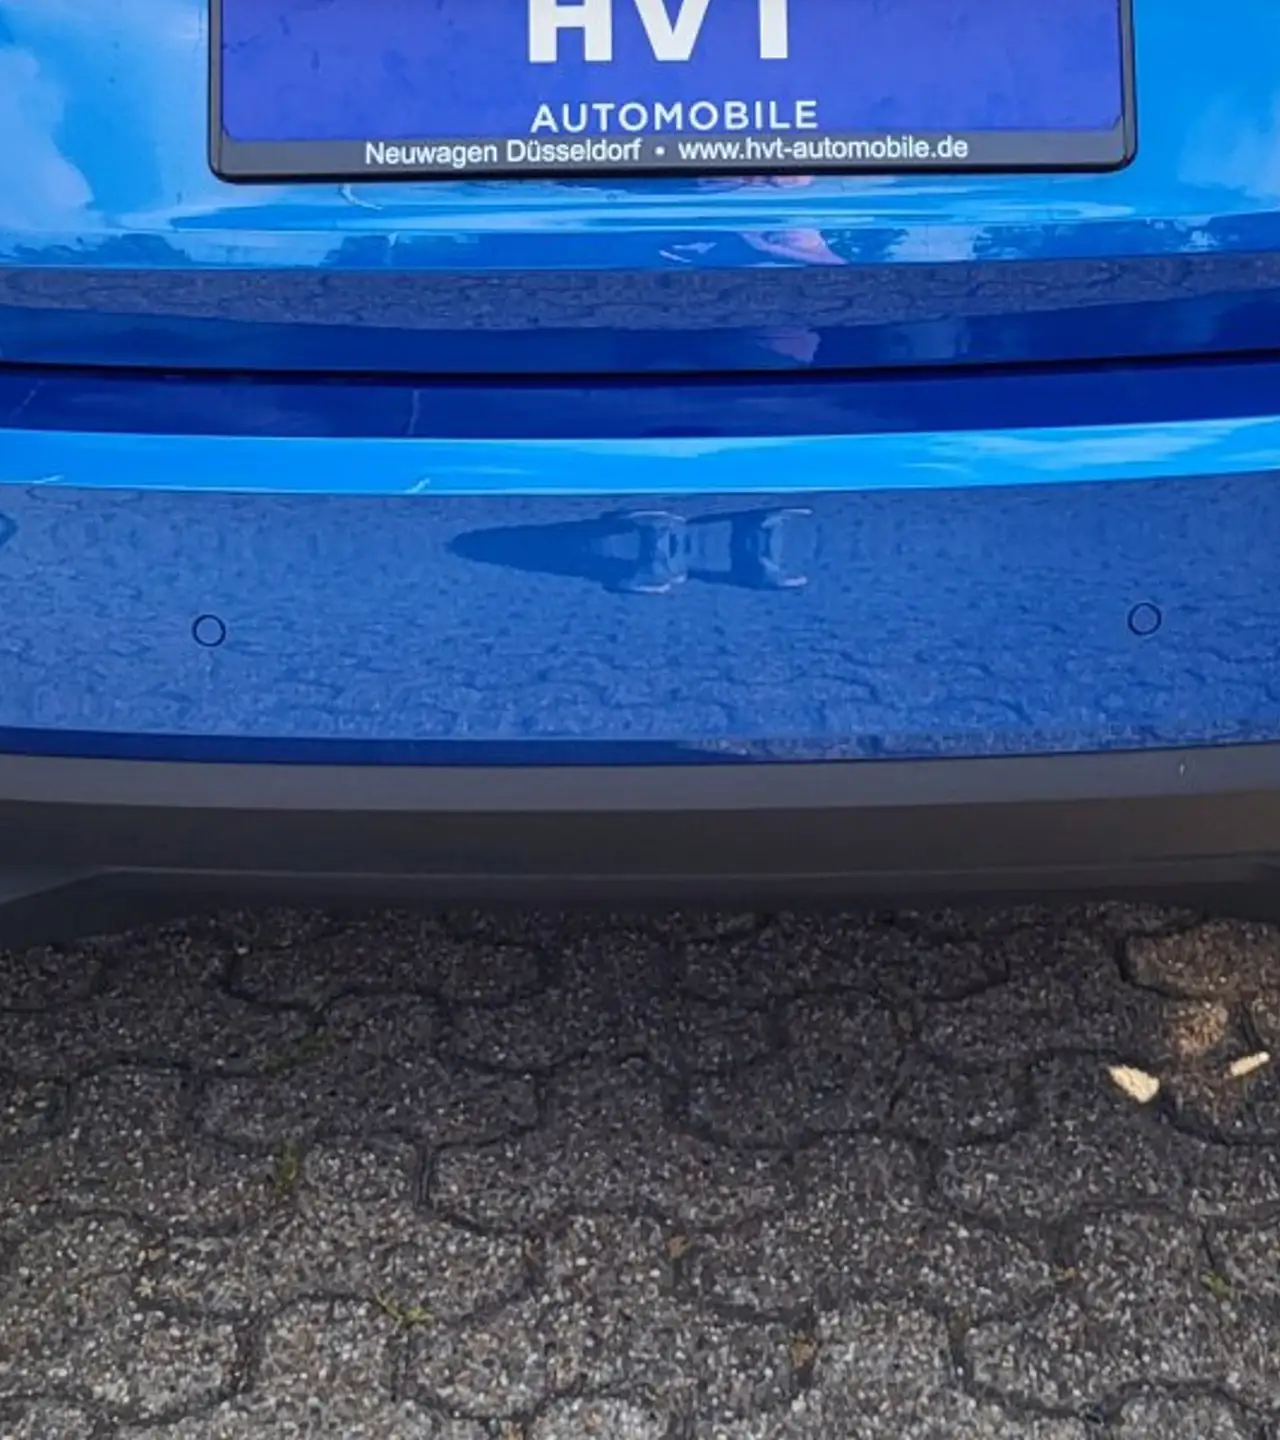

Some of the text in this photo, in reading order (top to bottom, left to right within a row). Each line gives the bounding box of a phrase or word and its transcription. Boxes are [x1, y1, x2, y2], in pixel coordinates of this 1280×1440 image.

[529, 100, 819, 134] AUTOMOBILE
[365, 134, 970, 168] Neuwagen Düsseldorf www.hvt-automobile.de
